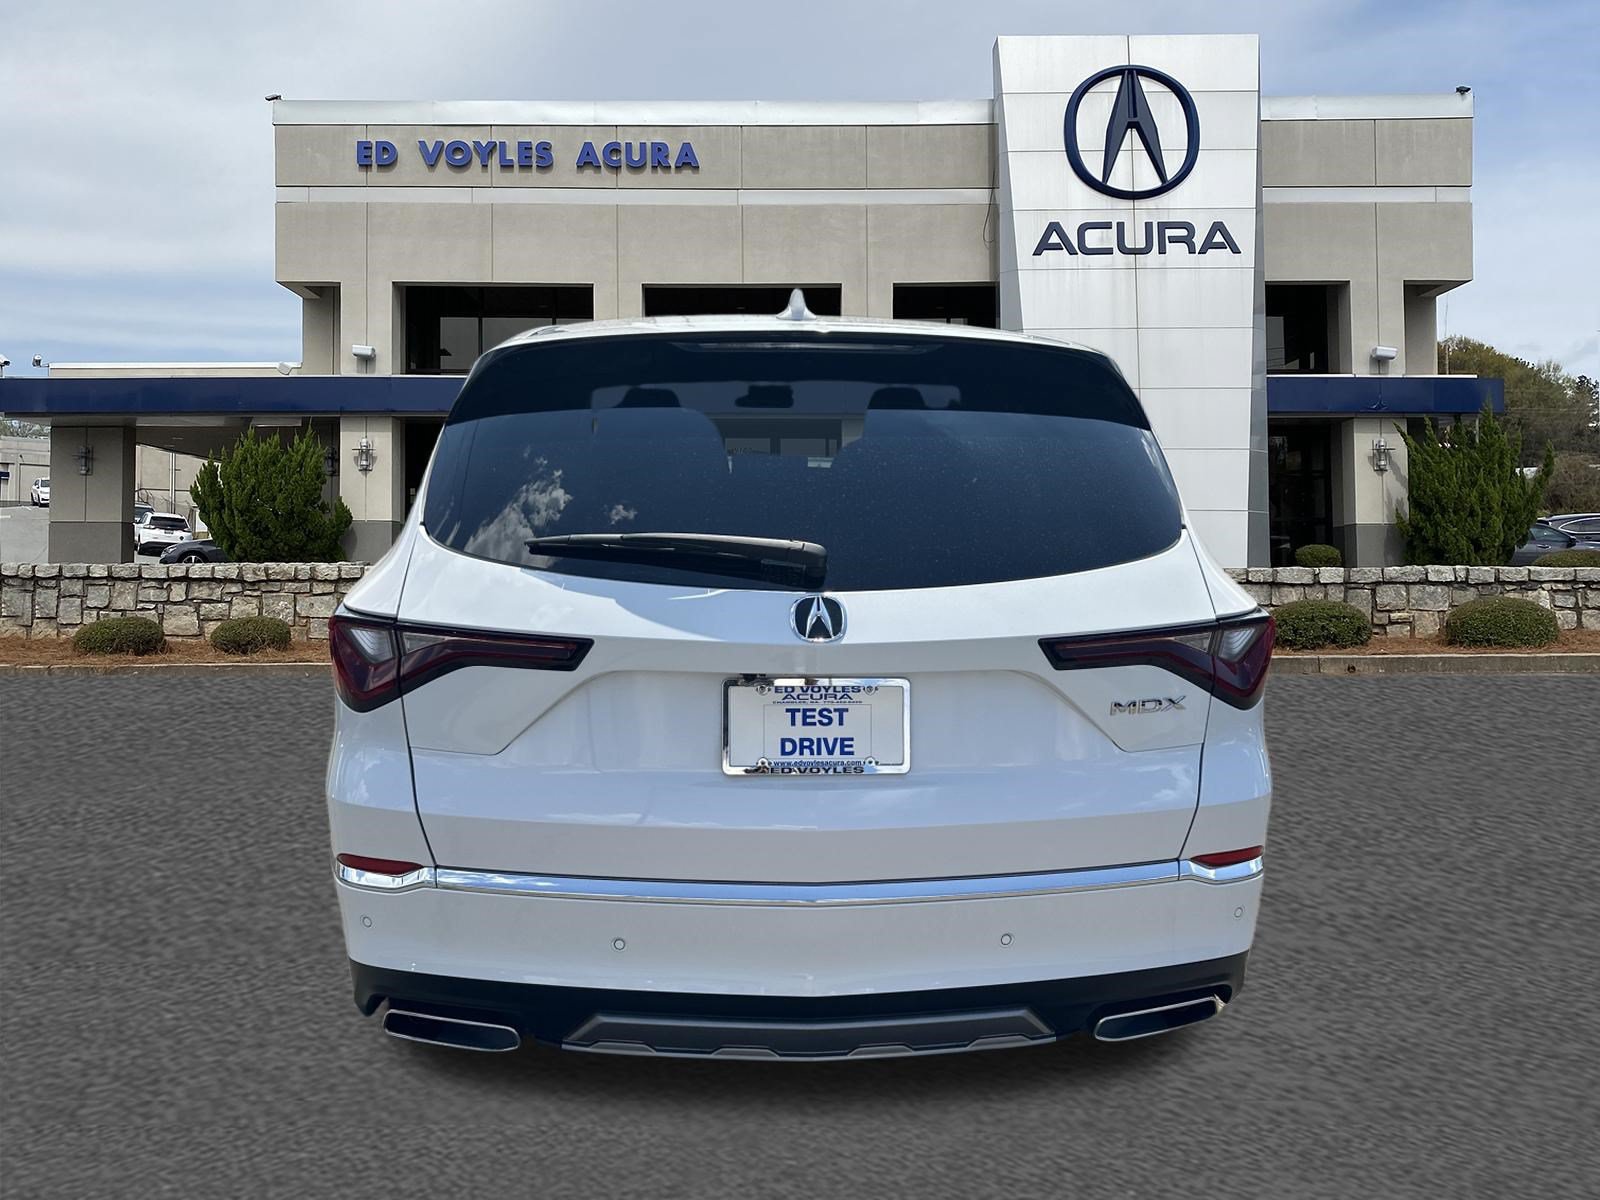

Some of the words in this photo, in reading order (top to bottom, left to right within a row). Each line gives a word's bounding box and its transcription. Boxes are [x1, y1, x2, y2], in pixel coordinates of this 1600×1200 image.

[356, 140, 398, 168] ED
[418, 140, 554, 169] VOYLES
[576, 141, 700, 170] ACURA
[1032, 221, 1242, 256] ACURA
[1110, 695, 1186, 716] MDX
[785, 709, 849, 727] TEST
[780, 737, 855, 756] DRIVE
